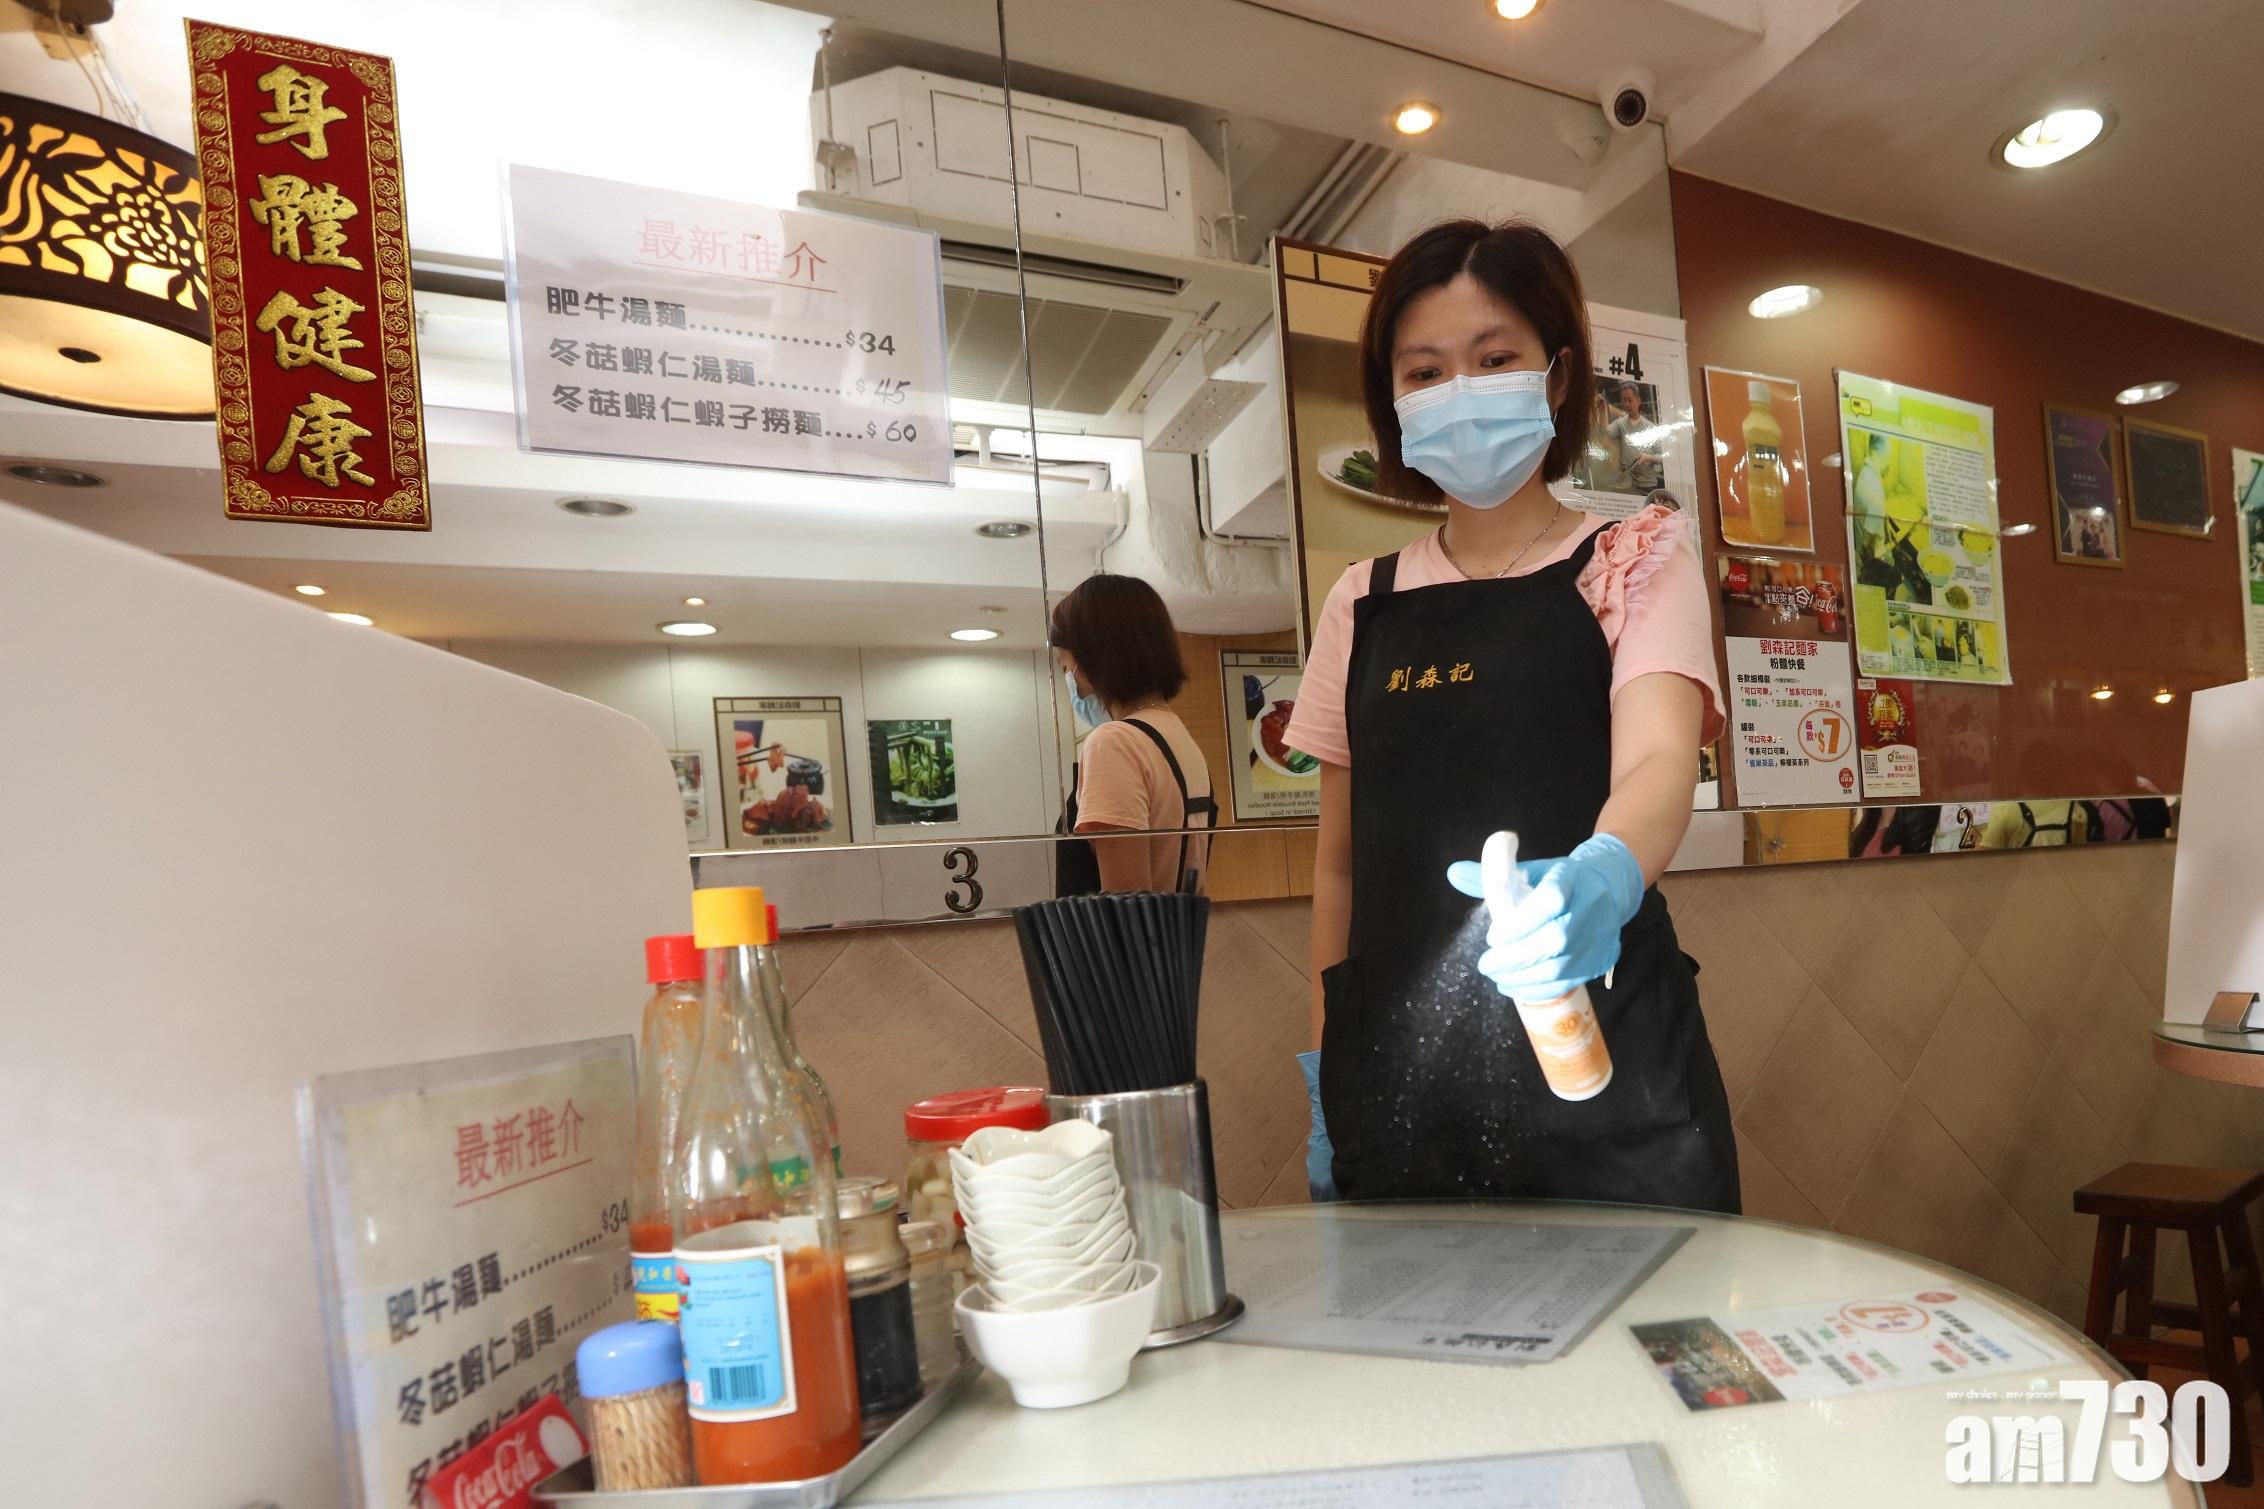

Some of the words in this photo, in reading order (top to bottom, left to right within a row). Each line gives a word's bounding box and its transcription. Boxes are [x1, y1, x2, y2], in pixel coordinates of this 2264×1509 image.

[638, 216, 828, 282] 最新推介
[249, 63, 378, 489] 身體健康
[1608, 342, 1644, 381] #4
[1760, 640, 1818, 656] 劉森記麵家
[1770, 658, 1806, 670] 粉麵快餐
[1385, 662, 1474, 693] 劉森記
[1957, 806, 1976, 849] 2
[943, 846, 984, 914] 3
[453, 1097, 585, 1189] 最新推介
